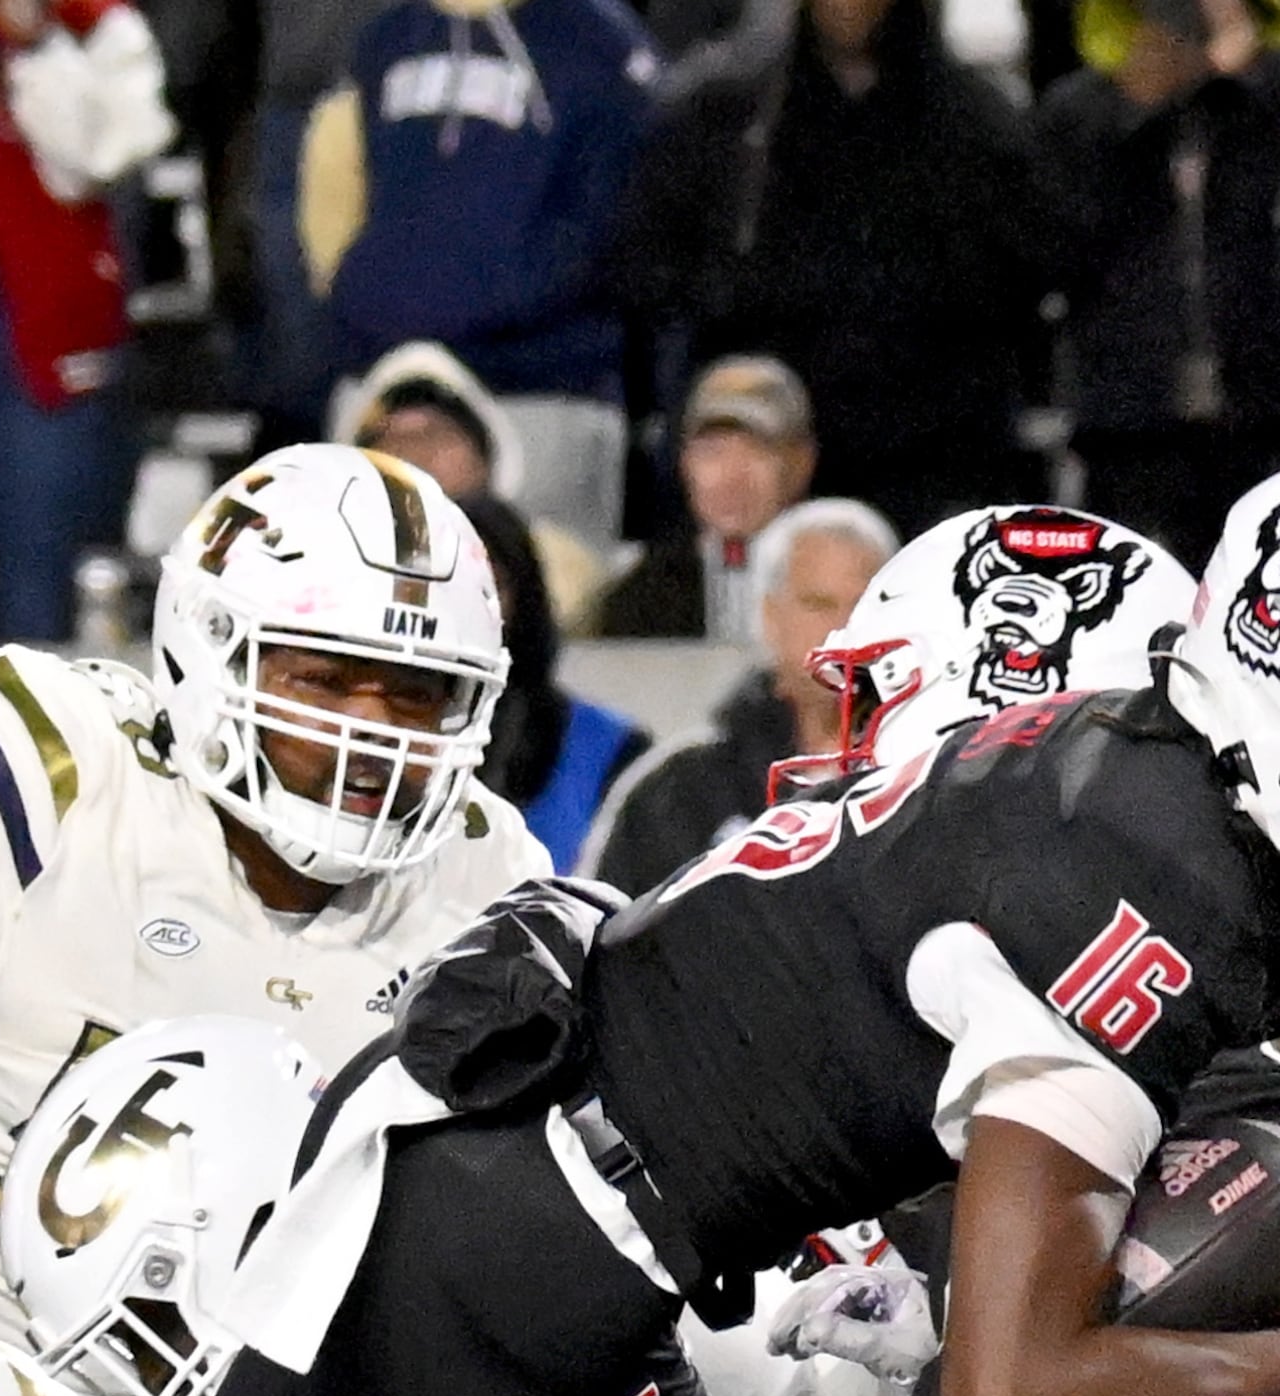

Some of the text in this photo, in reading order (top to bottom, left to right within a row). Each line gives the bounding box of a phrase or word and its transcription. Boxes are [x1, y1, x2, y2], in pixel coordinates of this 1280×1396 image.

[1008, 530, 1088, 549] NC STATE
[383, 606, 438, 640] UATW
[1045, 897, 1194, 1055] 16
[1164, 1138, 1241, 1197] adidas
[1207, 1160, 1269, 1217] DIME
